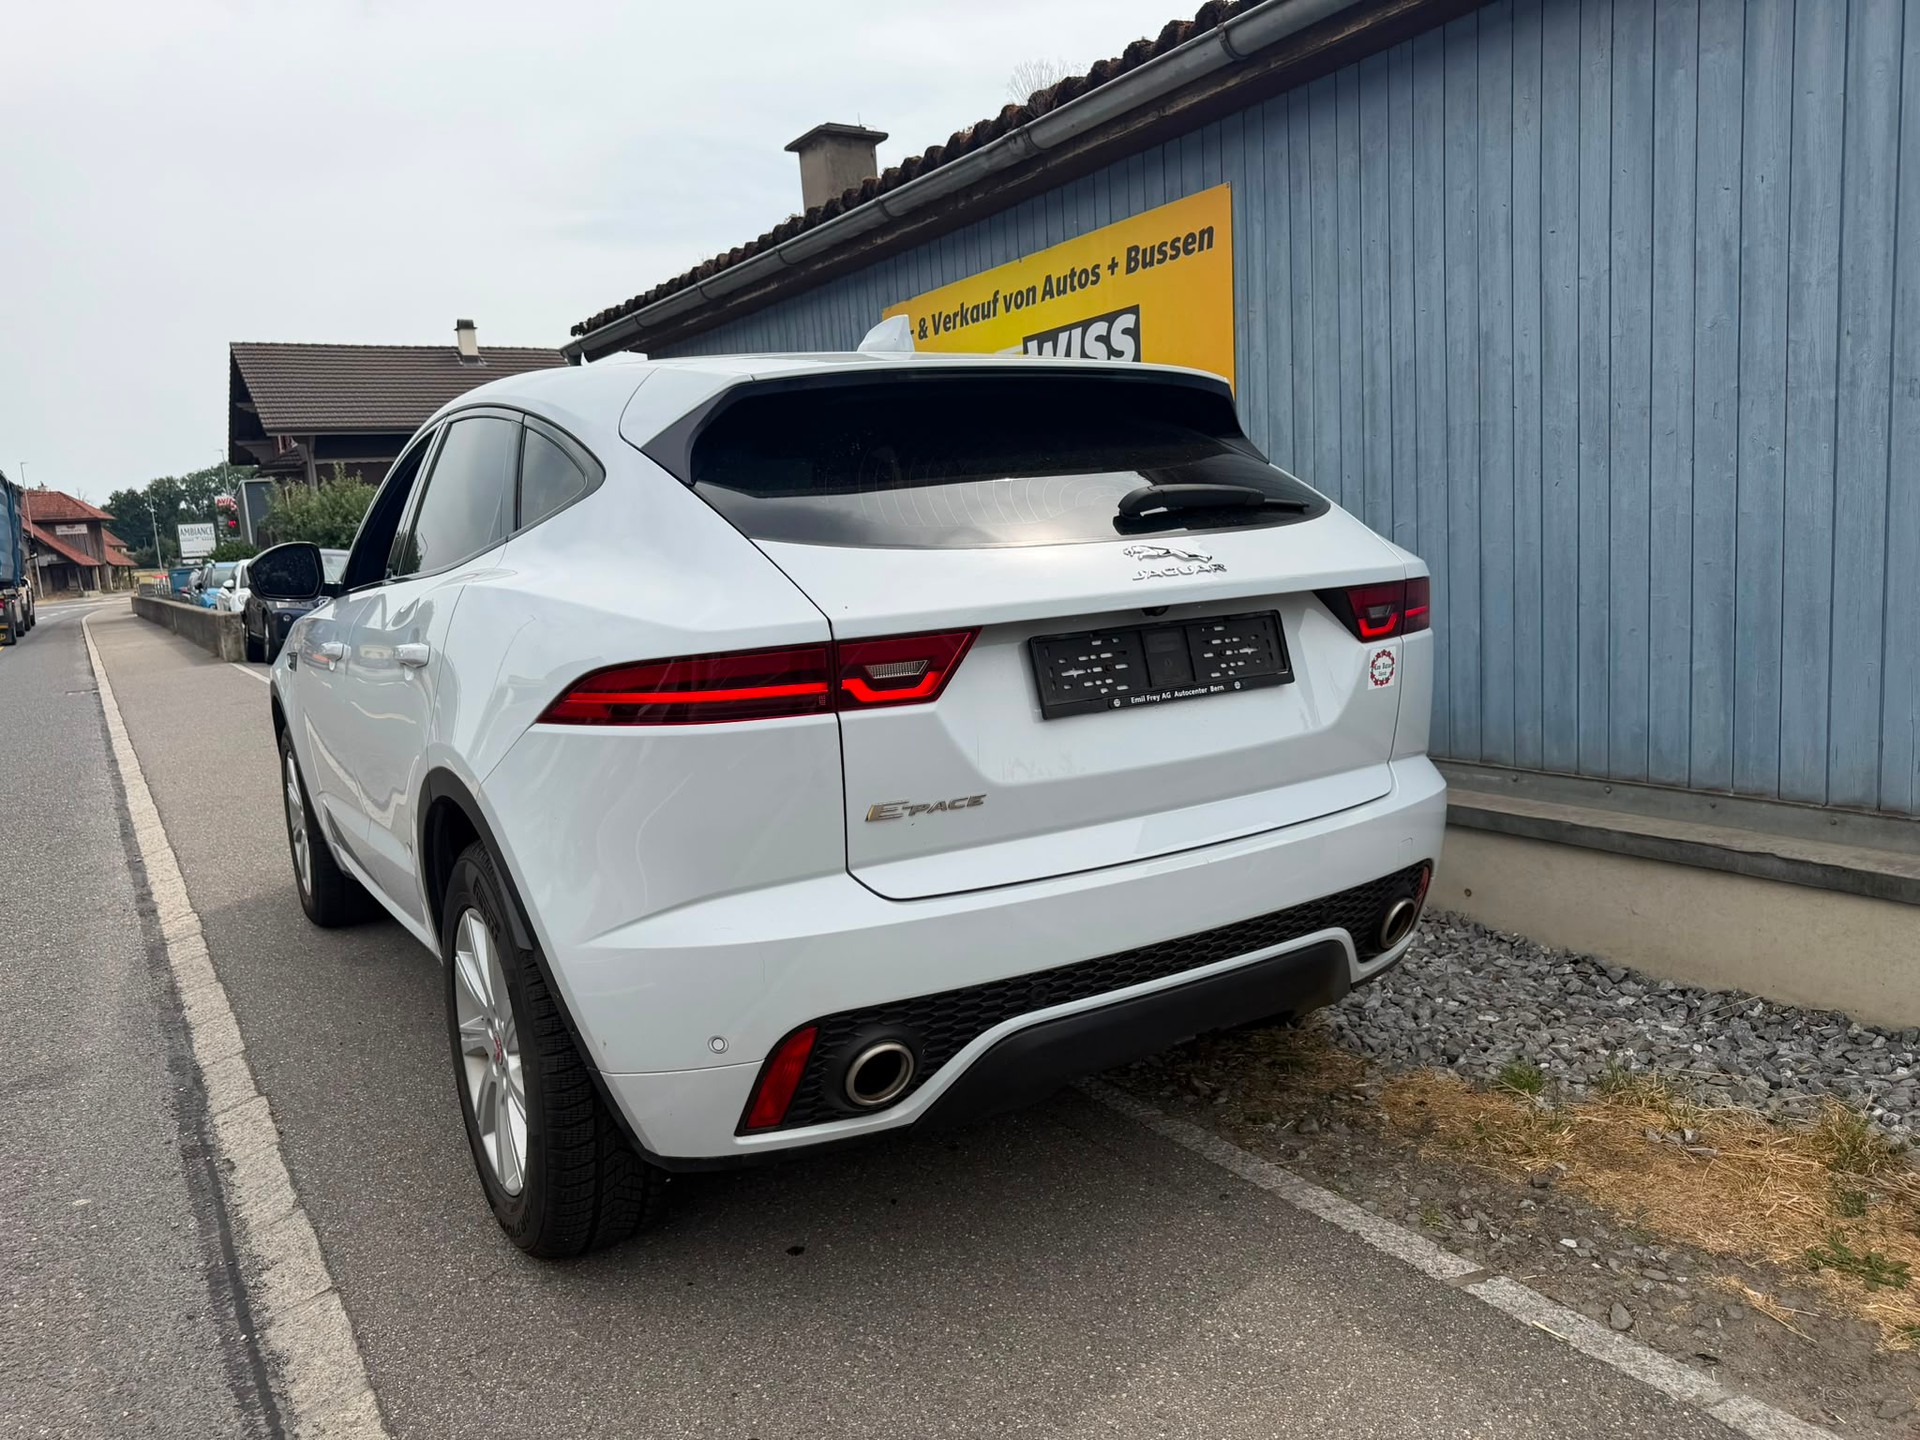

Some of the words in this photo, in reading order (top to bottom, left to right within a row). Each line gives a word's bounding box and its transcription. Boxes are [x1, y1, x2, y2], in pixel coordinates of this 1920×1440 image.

[918, 317, 929, 340] &
[931, 289, 1000, 336] Verkauf
[1002, 285, 1037, 313] von
[1041, 263, 1101, 303] Autos
[1107, 256, 1119, 276] +
[1125, 225, 1214, 275] Bussen
[180, 526, 214, 537] AMBIANCE
[1132, 564, 1228, 581] JAGUAR
[1130, 696, 1146, 704] Emil
[1146, 694, 1161, 702] Frey
[1161, 691, 1172, 700] AG
[1174, 687, 1208, 698] Autocenter
[1210, 684, 1225, 693] Bern
